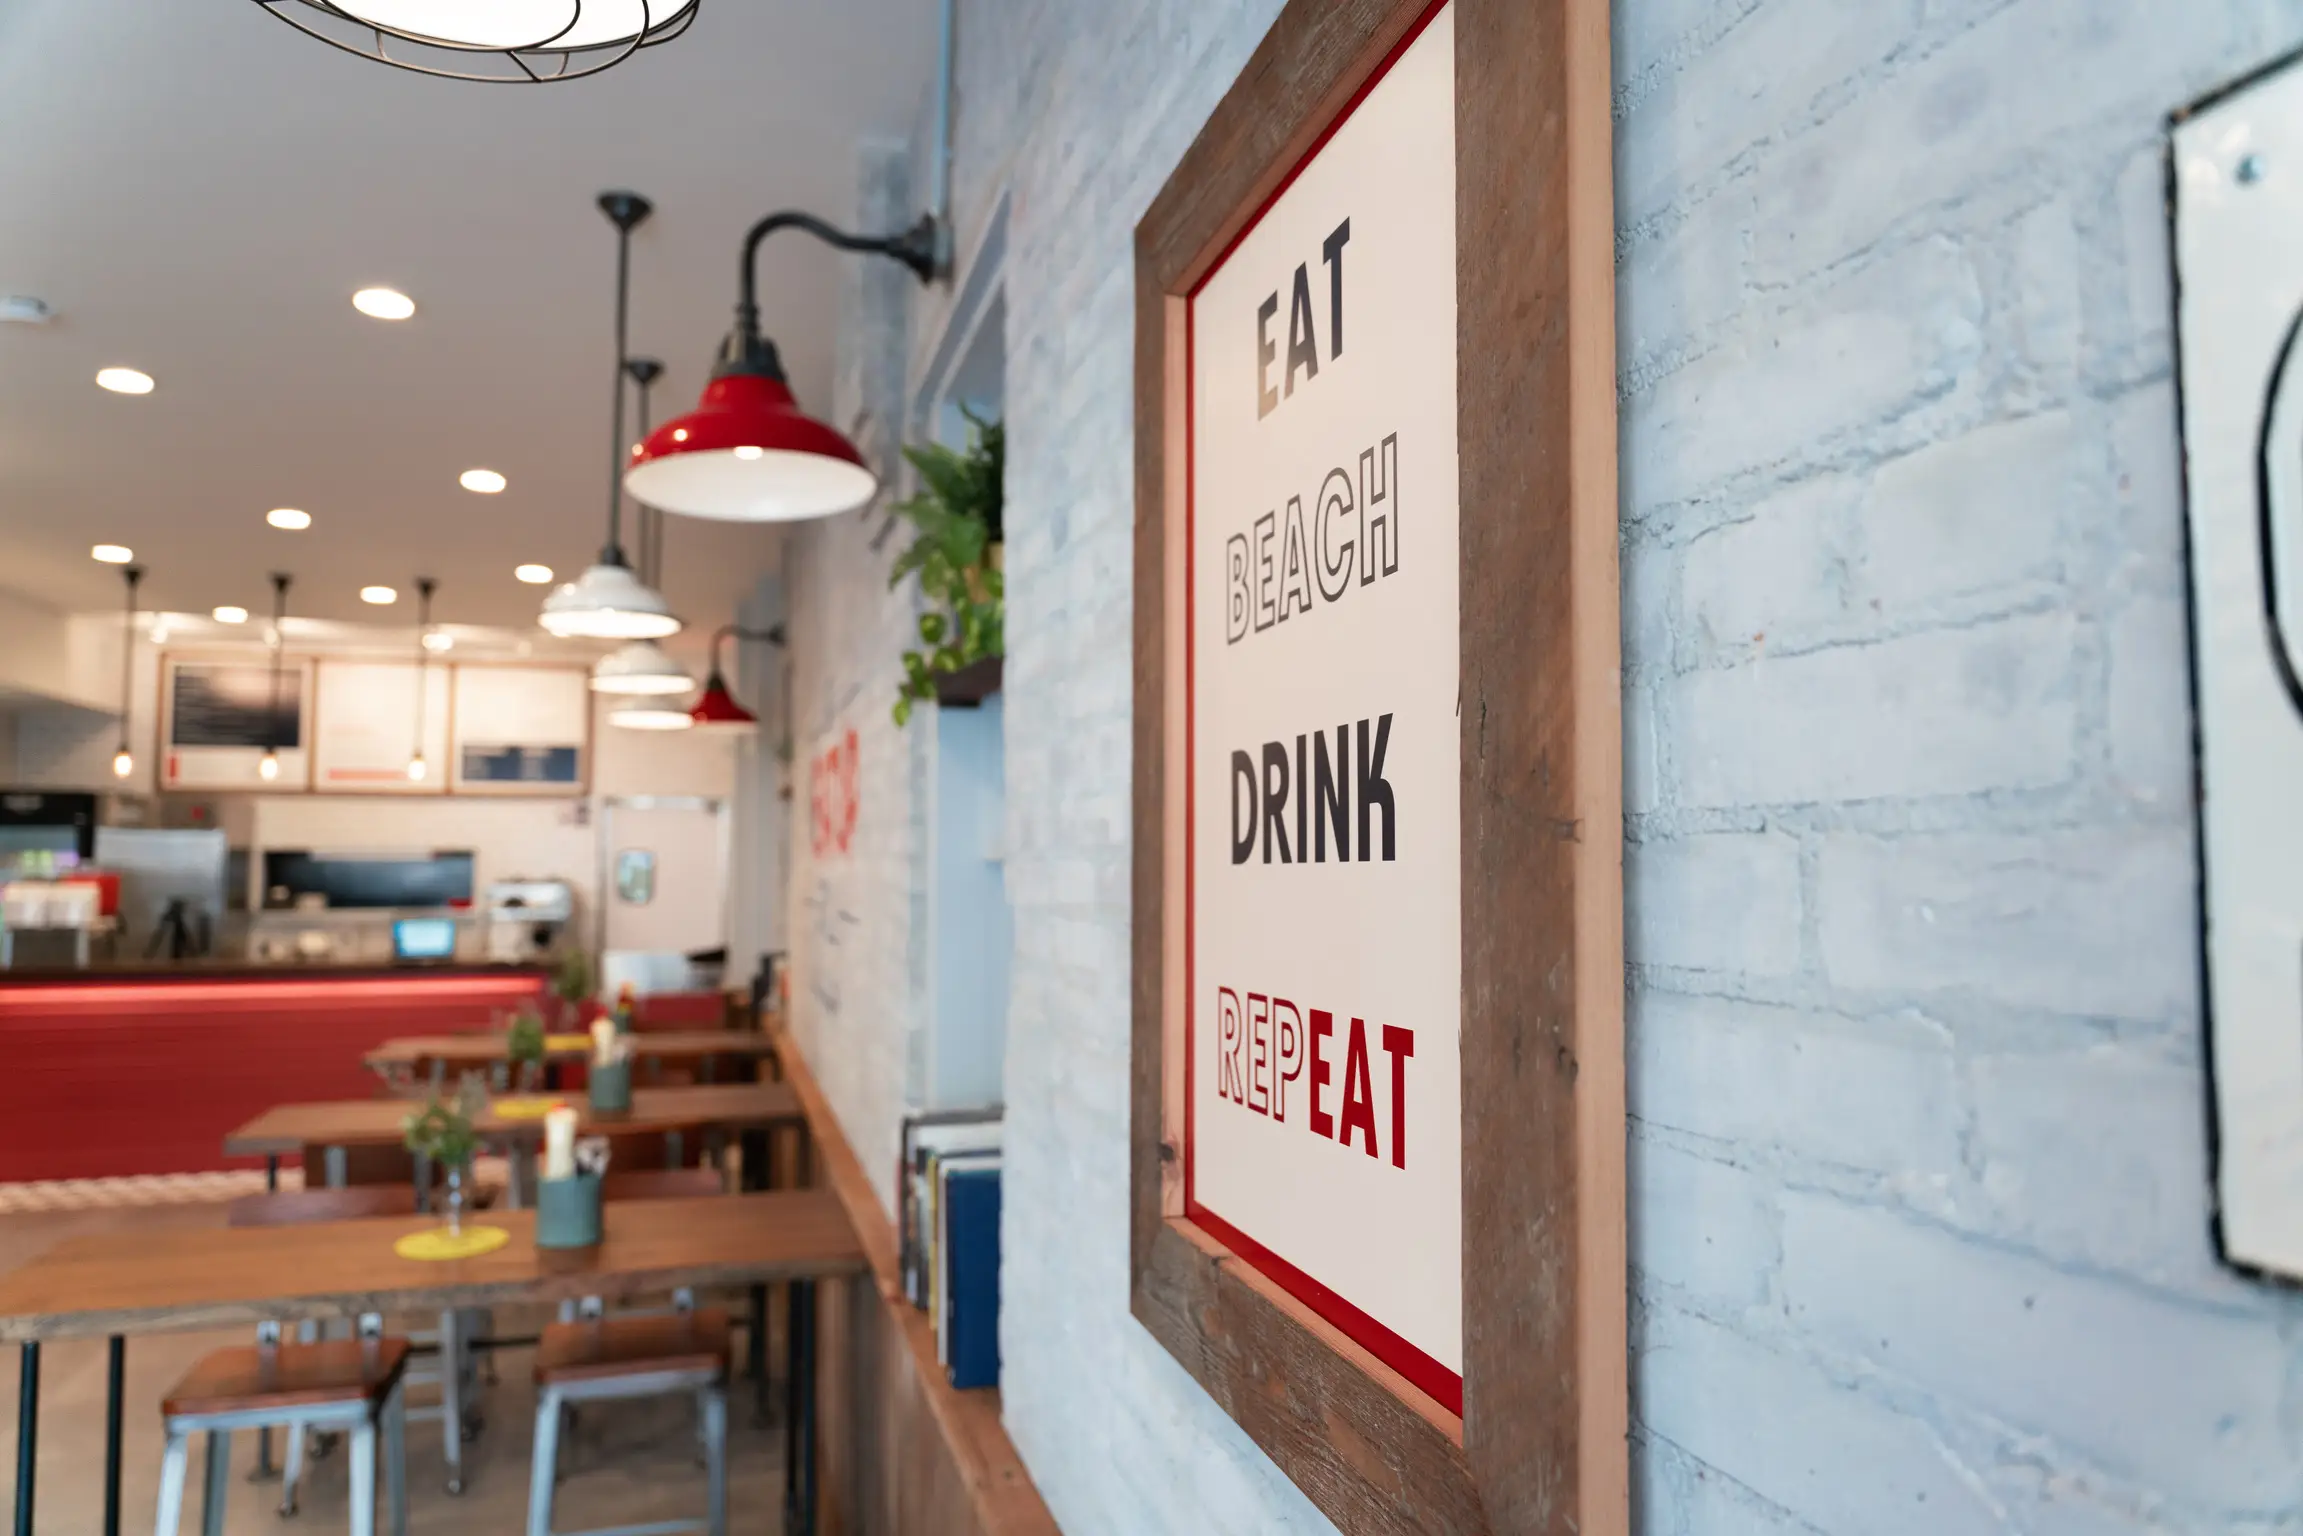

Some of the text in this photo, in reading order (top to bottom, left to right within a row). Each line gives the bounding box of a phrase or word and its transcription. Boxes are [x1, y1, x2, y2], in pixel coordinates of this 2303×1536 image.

[1257, 216, 1350, 421] EAT
[1226, 431, 1399, 645] BEACH
[1231, 712, 1396, 865] DRINK
[1217, 985, 1414, 1171] REPEAT
